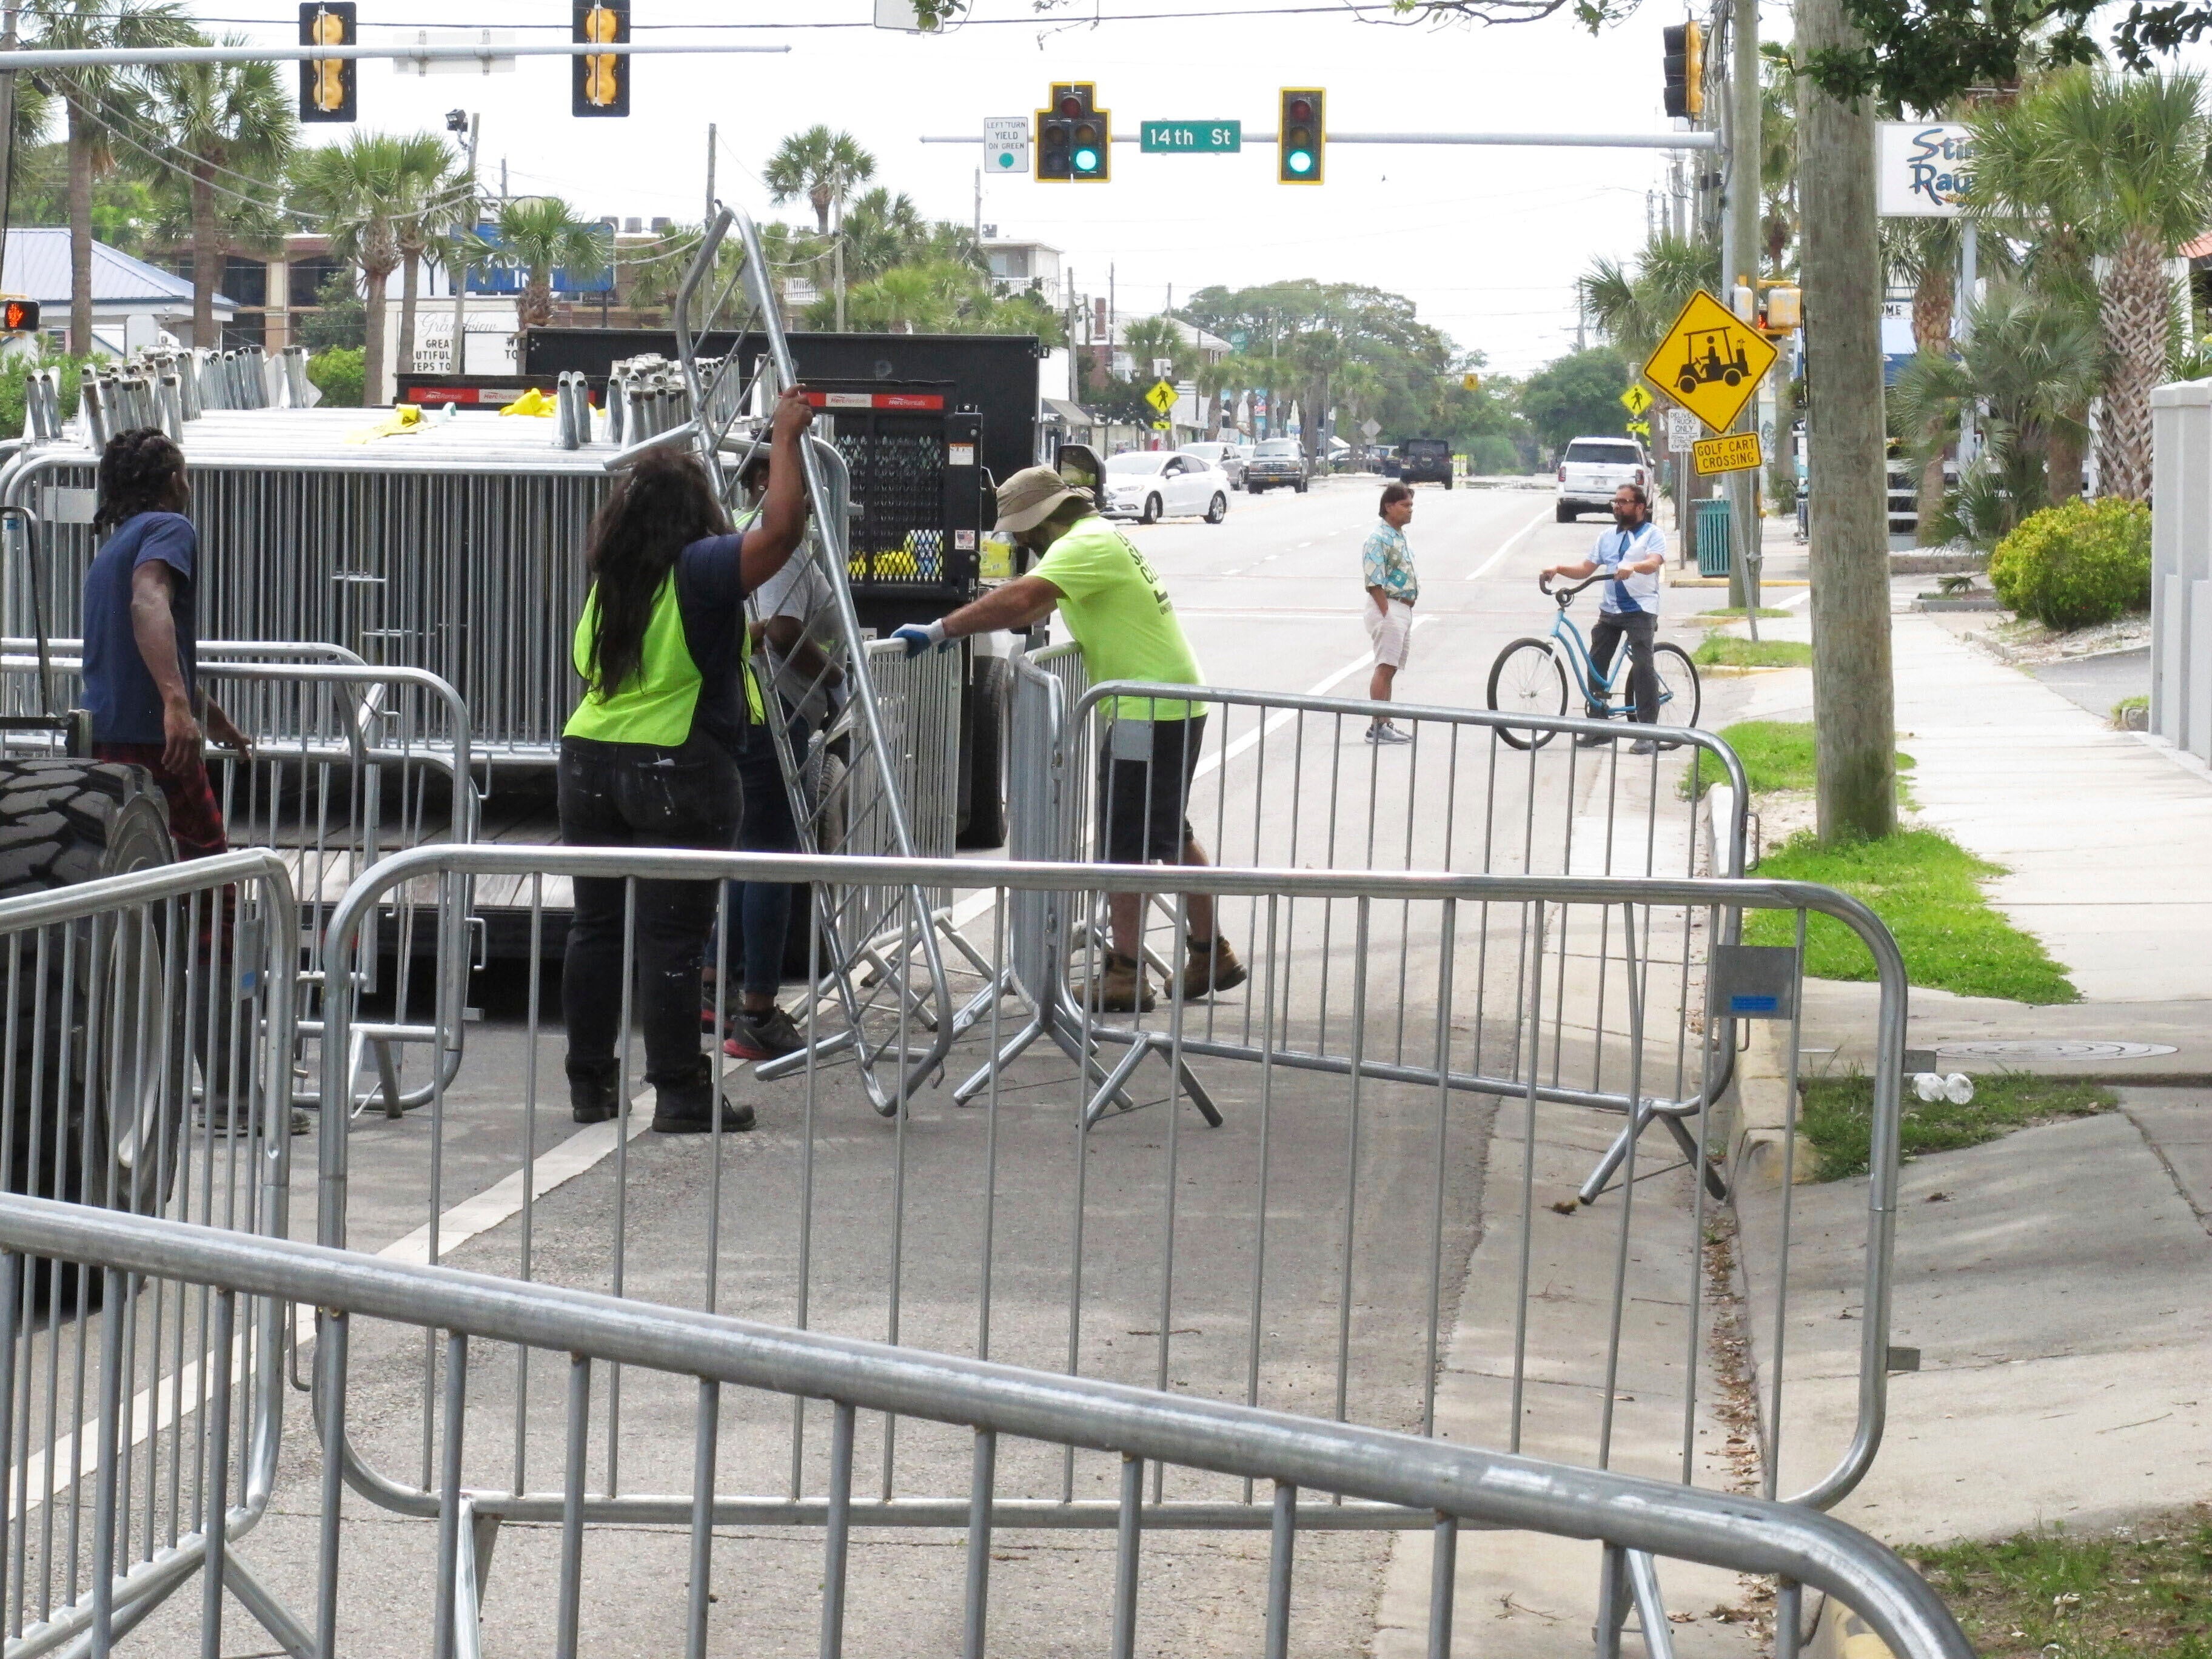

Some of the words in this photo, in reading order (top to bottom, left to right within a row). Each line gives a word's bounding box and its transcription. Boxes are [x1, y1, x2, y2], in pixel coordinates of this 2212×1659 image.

[1151, 129, 1193, 145] 14th
[1212, 129, 1231, 145] St
[416, 351, 450, 360] UTIFUL
[1697, 443, 1723, 456] GOLF
[1729, 438, 1754, 452] CART
[1703, 452, 1754, 469] CROSSING
